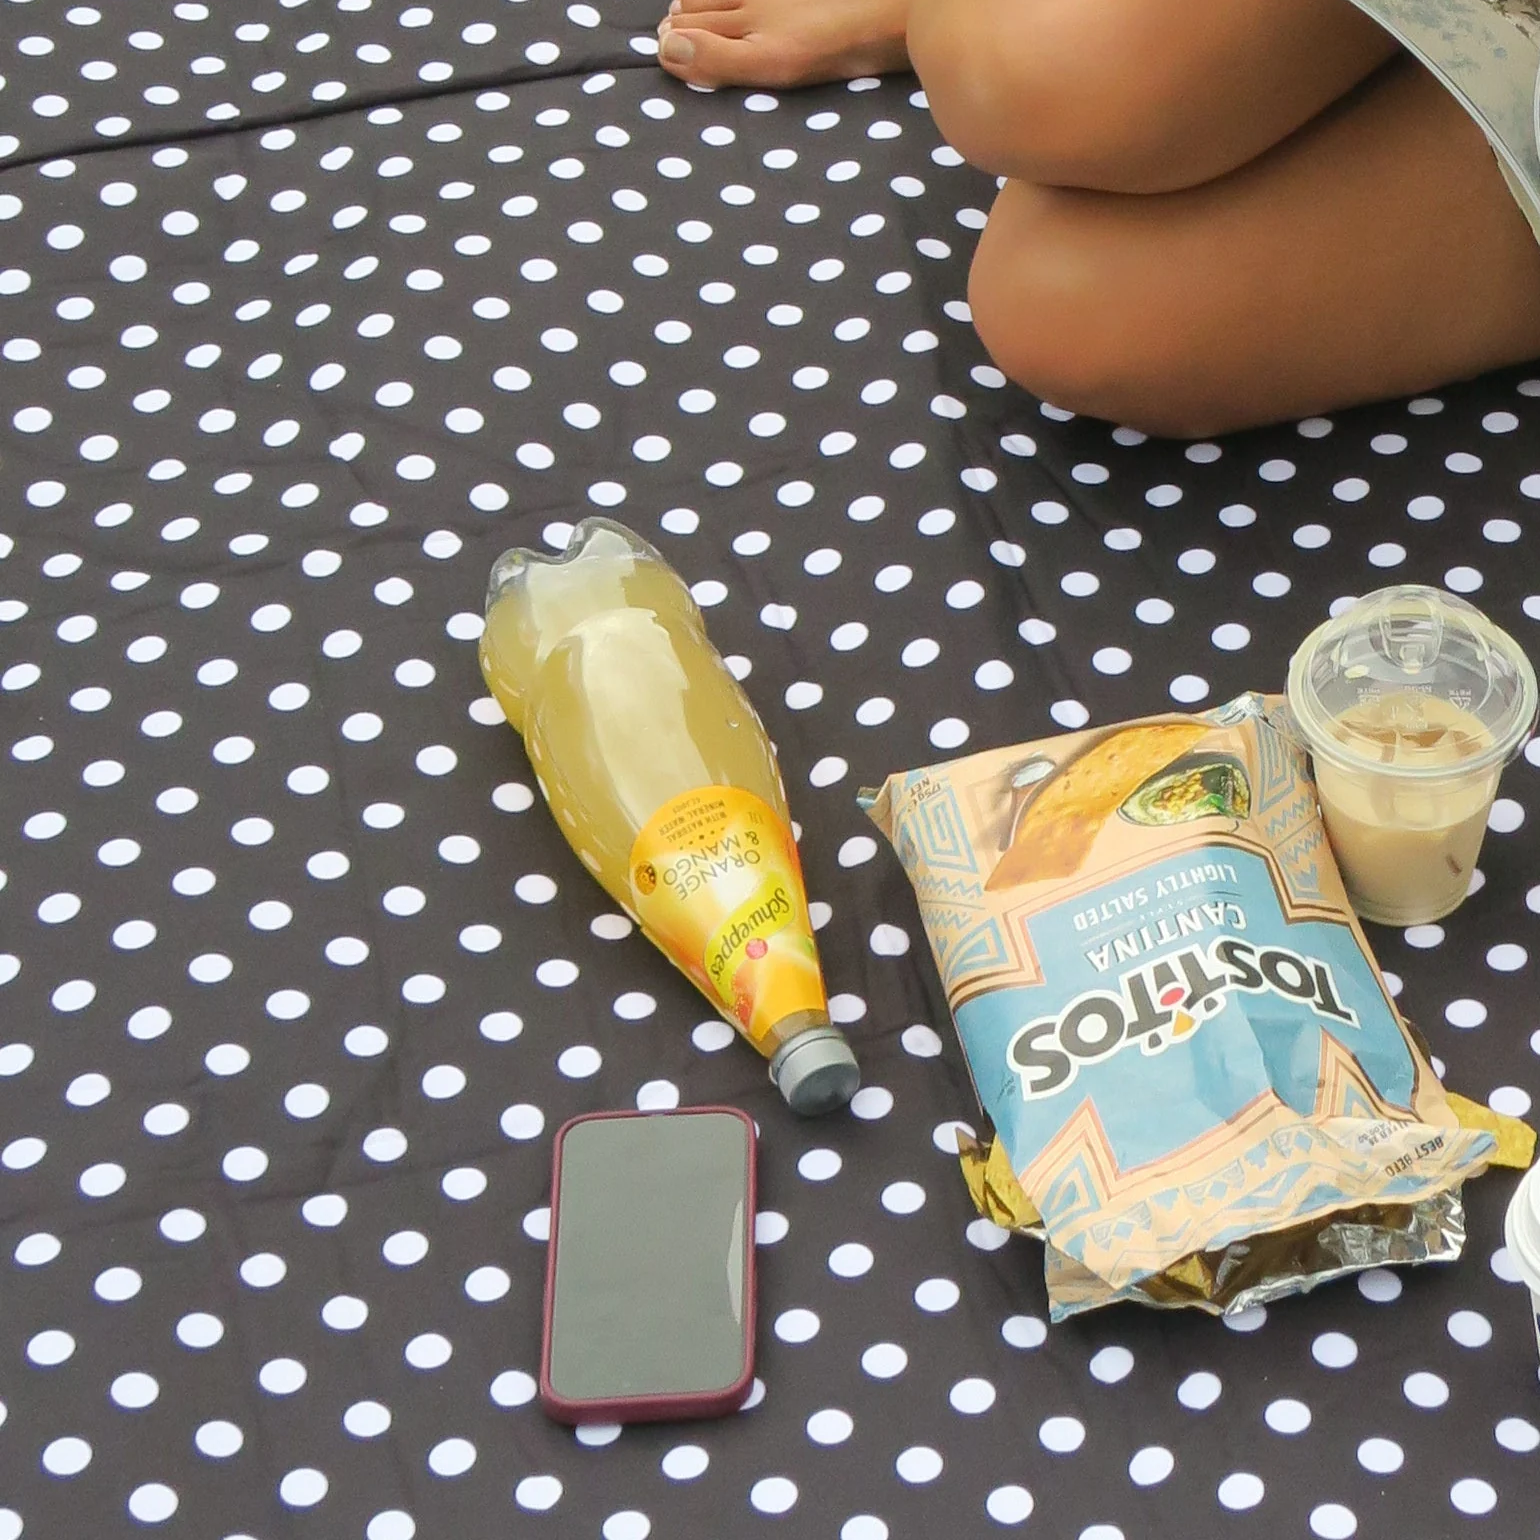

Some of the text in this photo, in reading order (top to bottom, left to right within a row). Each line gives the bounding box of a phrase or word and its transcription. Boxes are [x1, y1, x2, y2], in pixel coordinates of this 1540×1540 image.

[911, 777, 930, 798] NET
[662, 834, 741, 887] MANGO
[744, 830, 760, 846] &
[673, 849, 761, 901] ORANGE
[1072, 864, 1239, 932] LIGHTLY SALTED
[711, 887, 790, 984] Schweppes
[1085, 900, 1248, 974] CANTINA
[1414, 1135, 1445, 1161] BEST
